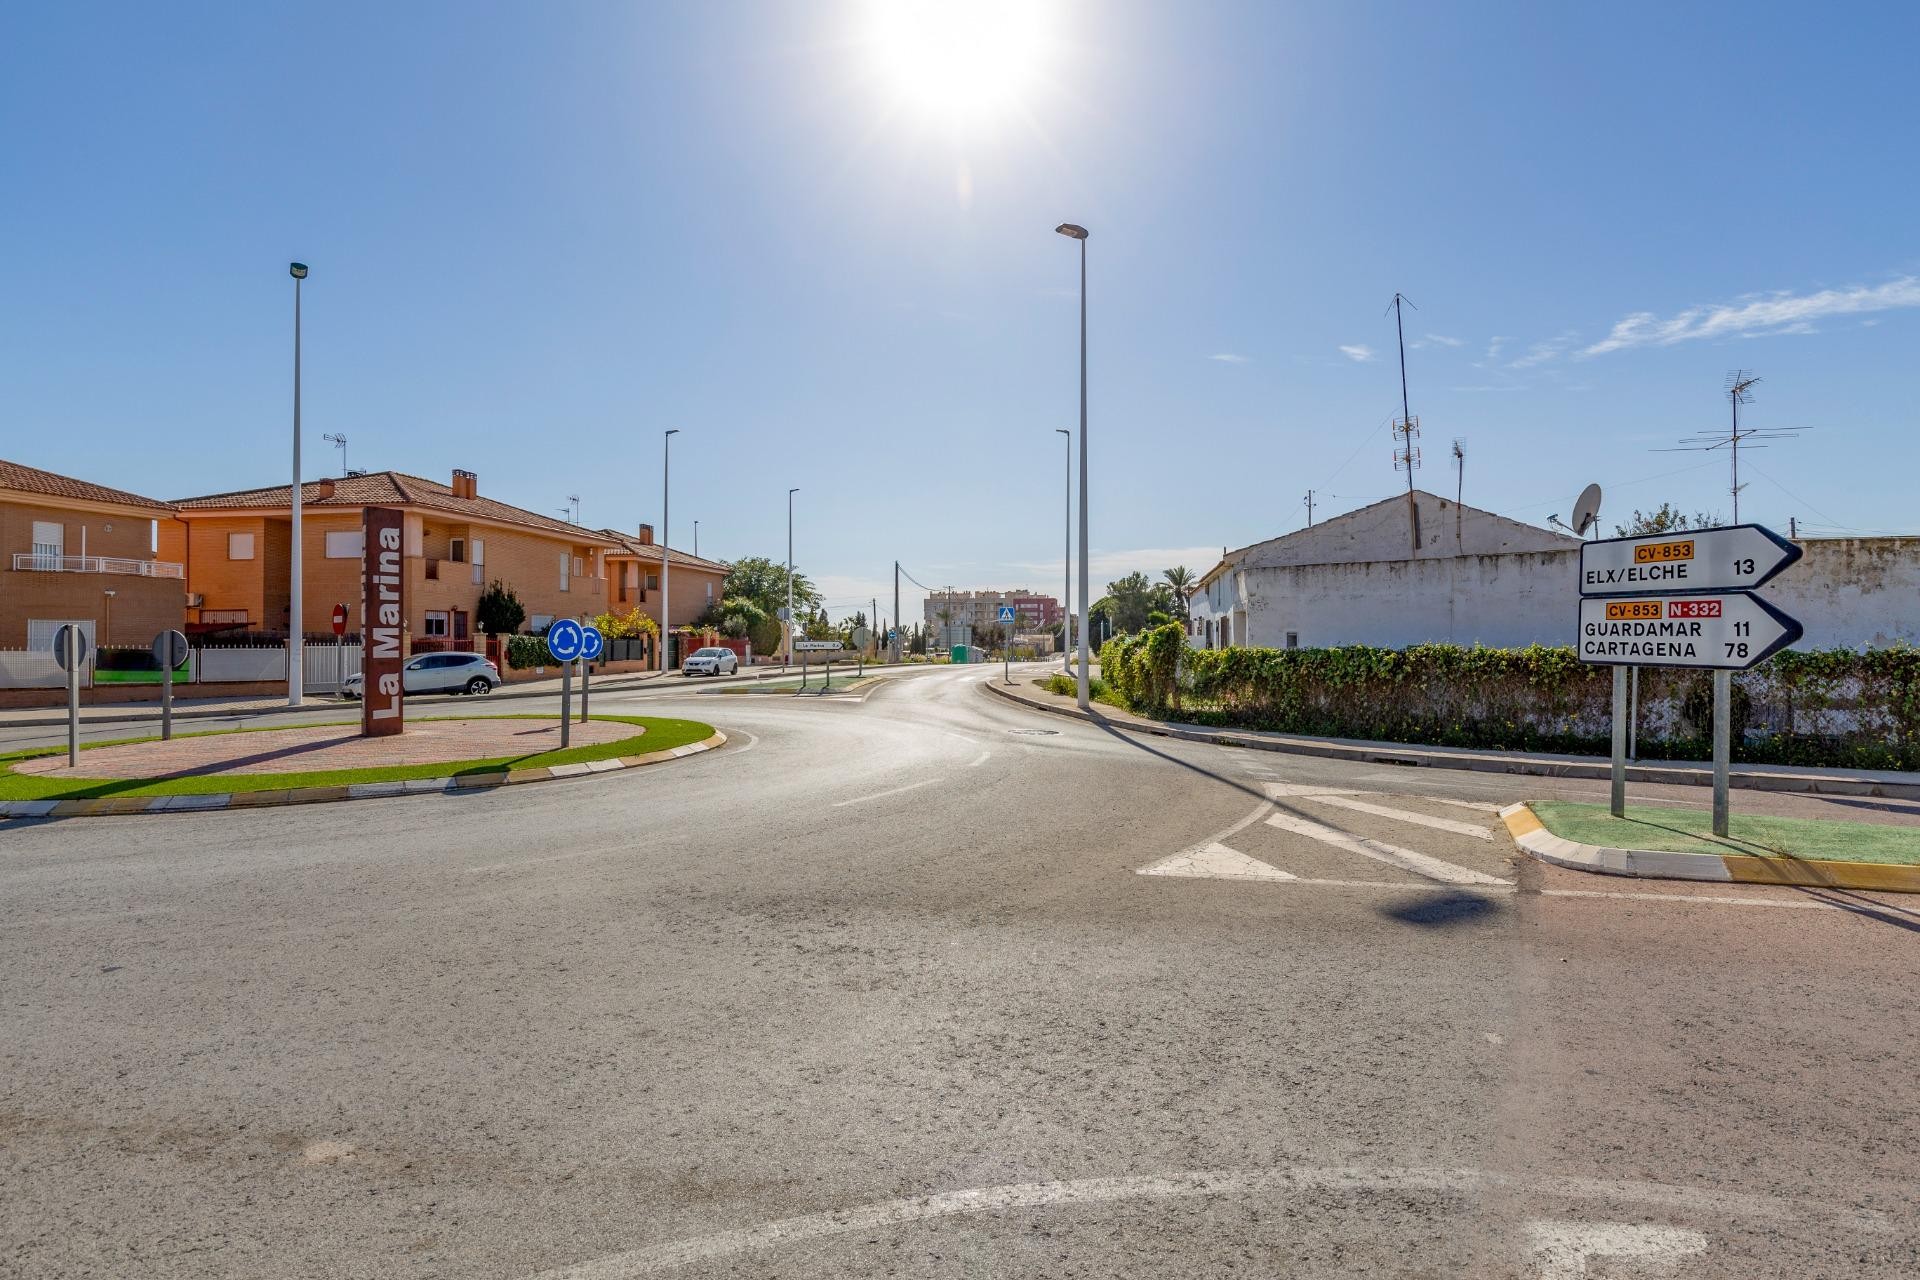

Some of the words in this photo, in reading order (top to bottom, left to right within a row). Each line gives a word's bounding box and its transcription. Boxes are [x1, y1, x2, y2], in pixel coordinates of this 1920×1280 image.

[1637, 544, 1691, 561] CV-853
[1586, 563, 1688, 584] ELX/ELCHE
[1733, 558, 1755, 575] 13
[372, 527, 400, 659] Marina
[1608, 604, 1659, 617] CV-853
[1670, 603, 1720, 617] N-332
[1585, 622, 1702, 637] GUARDAMAR
[1733, 621, 1750, 637] 11
[1584, 641, 1697, 658] CARTAGENA
[1724, 643, 1749, 658] 78
[372, 672, 400, 720] La
